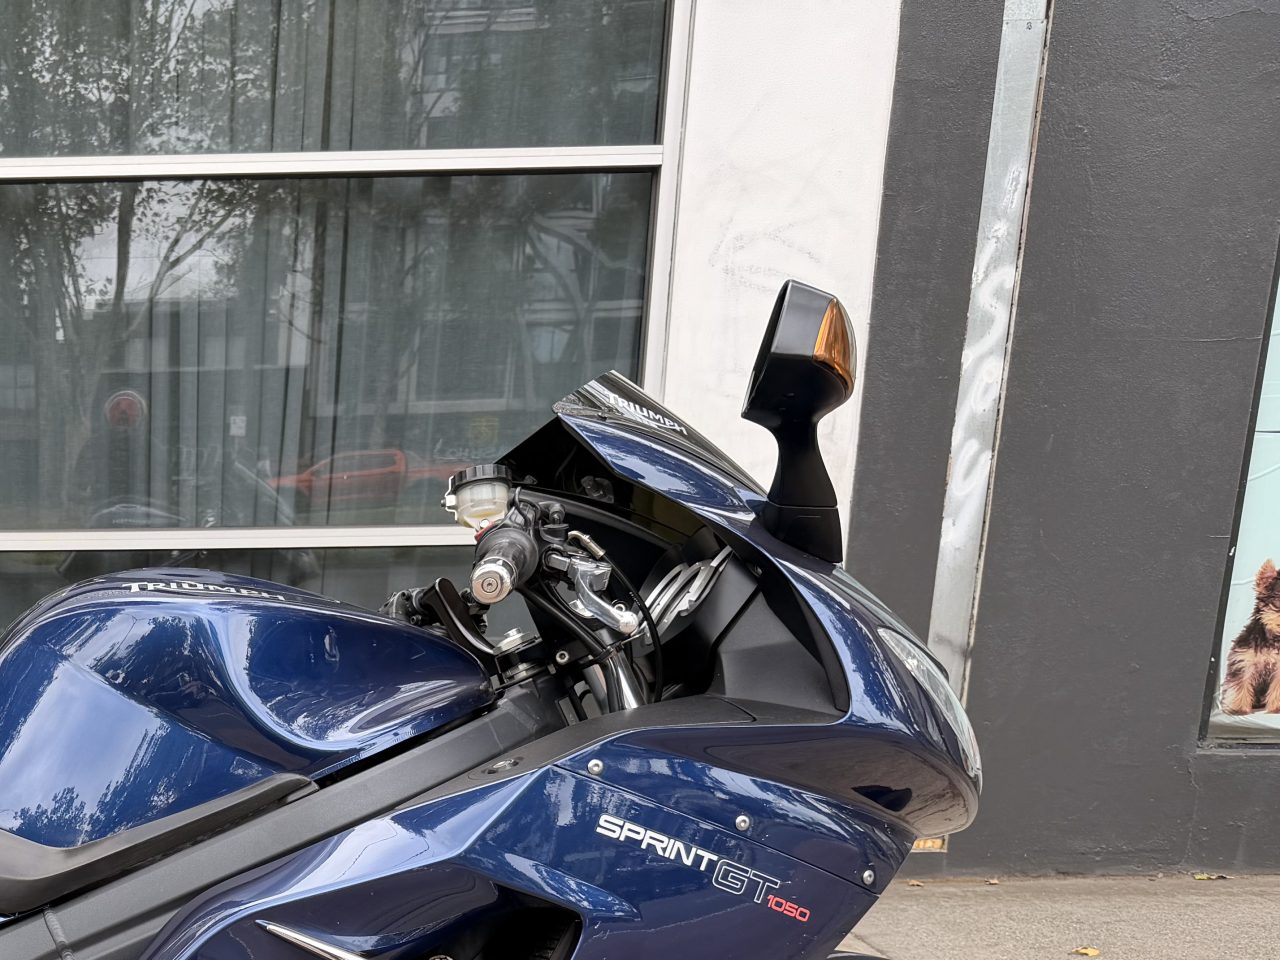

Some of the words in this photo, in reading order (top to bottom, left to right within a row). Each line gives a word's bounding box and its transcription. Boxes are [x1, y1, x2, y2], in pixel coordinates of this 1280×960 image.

[608, 392, 688, 435] TRIUMPH
[122, 581, 286, 600] TRIUMPH
[595, 814, 718, 871] SPRINT
[712, 859, 780, 904] GT
[767, 894, 811, 922] 1050
